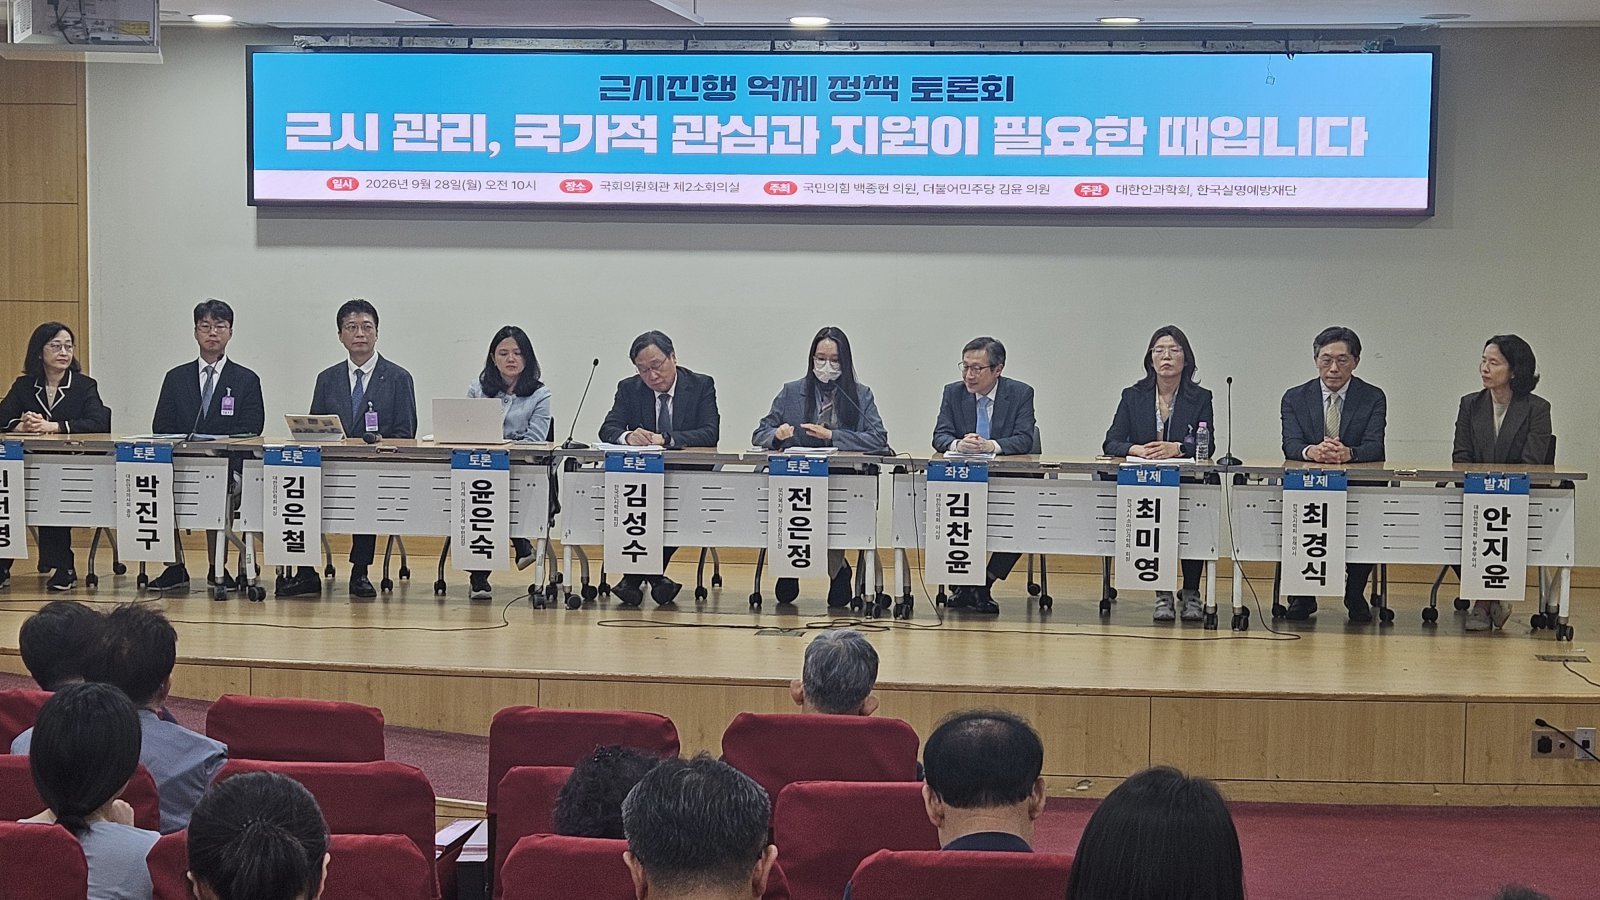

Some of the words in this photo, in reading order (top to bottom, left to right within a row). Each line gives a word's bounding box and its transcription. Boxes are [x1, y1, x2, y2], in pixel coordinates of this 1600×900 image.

[599, 75, 737, 102] 근시진행
[748, 75, 818, 102] 억제
[827, 75, 899, 102] 정책
[910, 75, 1015, 102] 토론회
[285, 112, 379, 151] 근시
[393, 113, 501, 158] 관리,
[514, 114, 658, 154] 국가적
[672, 115, 820, 155] 관심과
[830, 115, 979, 156] 지원이
[993, 115, 1148, 156] 필요한
[1159, 116, 1369, 157] 때입니다
[331, 178, 353, 190] 일시
[365, 178, 409, 190] 2026년
[412, 178, 431, 190] 9월
[435, 178, 482, 191] 28일(월)
[485, 179, 508, 191] 오전
[511, 179, 537, 191] 10시
[564, 180, 587, 192] 장소
[599, 180, 670, 192] 국회의원회관
[673, 181, 740, 193] 제2소회의실
[769, 182, 791, 194] 주최
[803, 182, 850, 194] 국민의힘
[854, 182, 890, 195] 백종헌
[893, 183, 920, 196] 의원,
[923, 183, 996, 195] 더불어민주당
[998, 183, 1023, 195] 김윤
[1026, 183, 1050, 195] 의원
[1080, 184, 1102, 196] 주관
[1115, 184, 1193, 197] 대한안과학회,
[1197, 185, 1298, 197] 한국실명예방재단
[133, 447, 156, 460] 토론
[281, 450, 304, 464] 토론
[469, 454, 492, 467] 토론
[623, 457, 647, 470] 토론
[786, 460, 810, 473] 토론
[944, 466, 970, 479] 좌장
[1136, 469, 1161, 483] 발제
[1302, 474, 1328, 488] 발제
[1483, 478, 1510, 491] 발제
[135, 475, 160, 550] 박진구
[282, 476, 306, 553] 김은철
[469, 480, 495, 559] 윤은숙
[621, 483, 648, 563] 김성수
[787, 487, 812, 568] 전은정
[945, 493, 972, 574] 김찬윤
[1134, 498, 1161, 582] 최미영
[1301, 503, 1328, 586] 최경식
[1482, 507, 1511, 589] 안지윤
